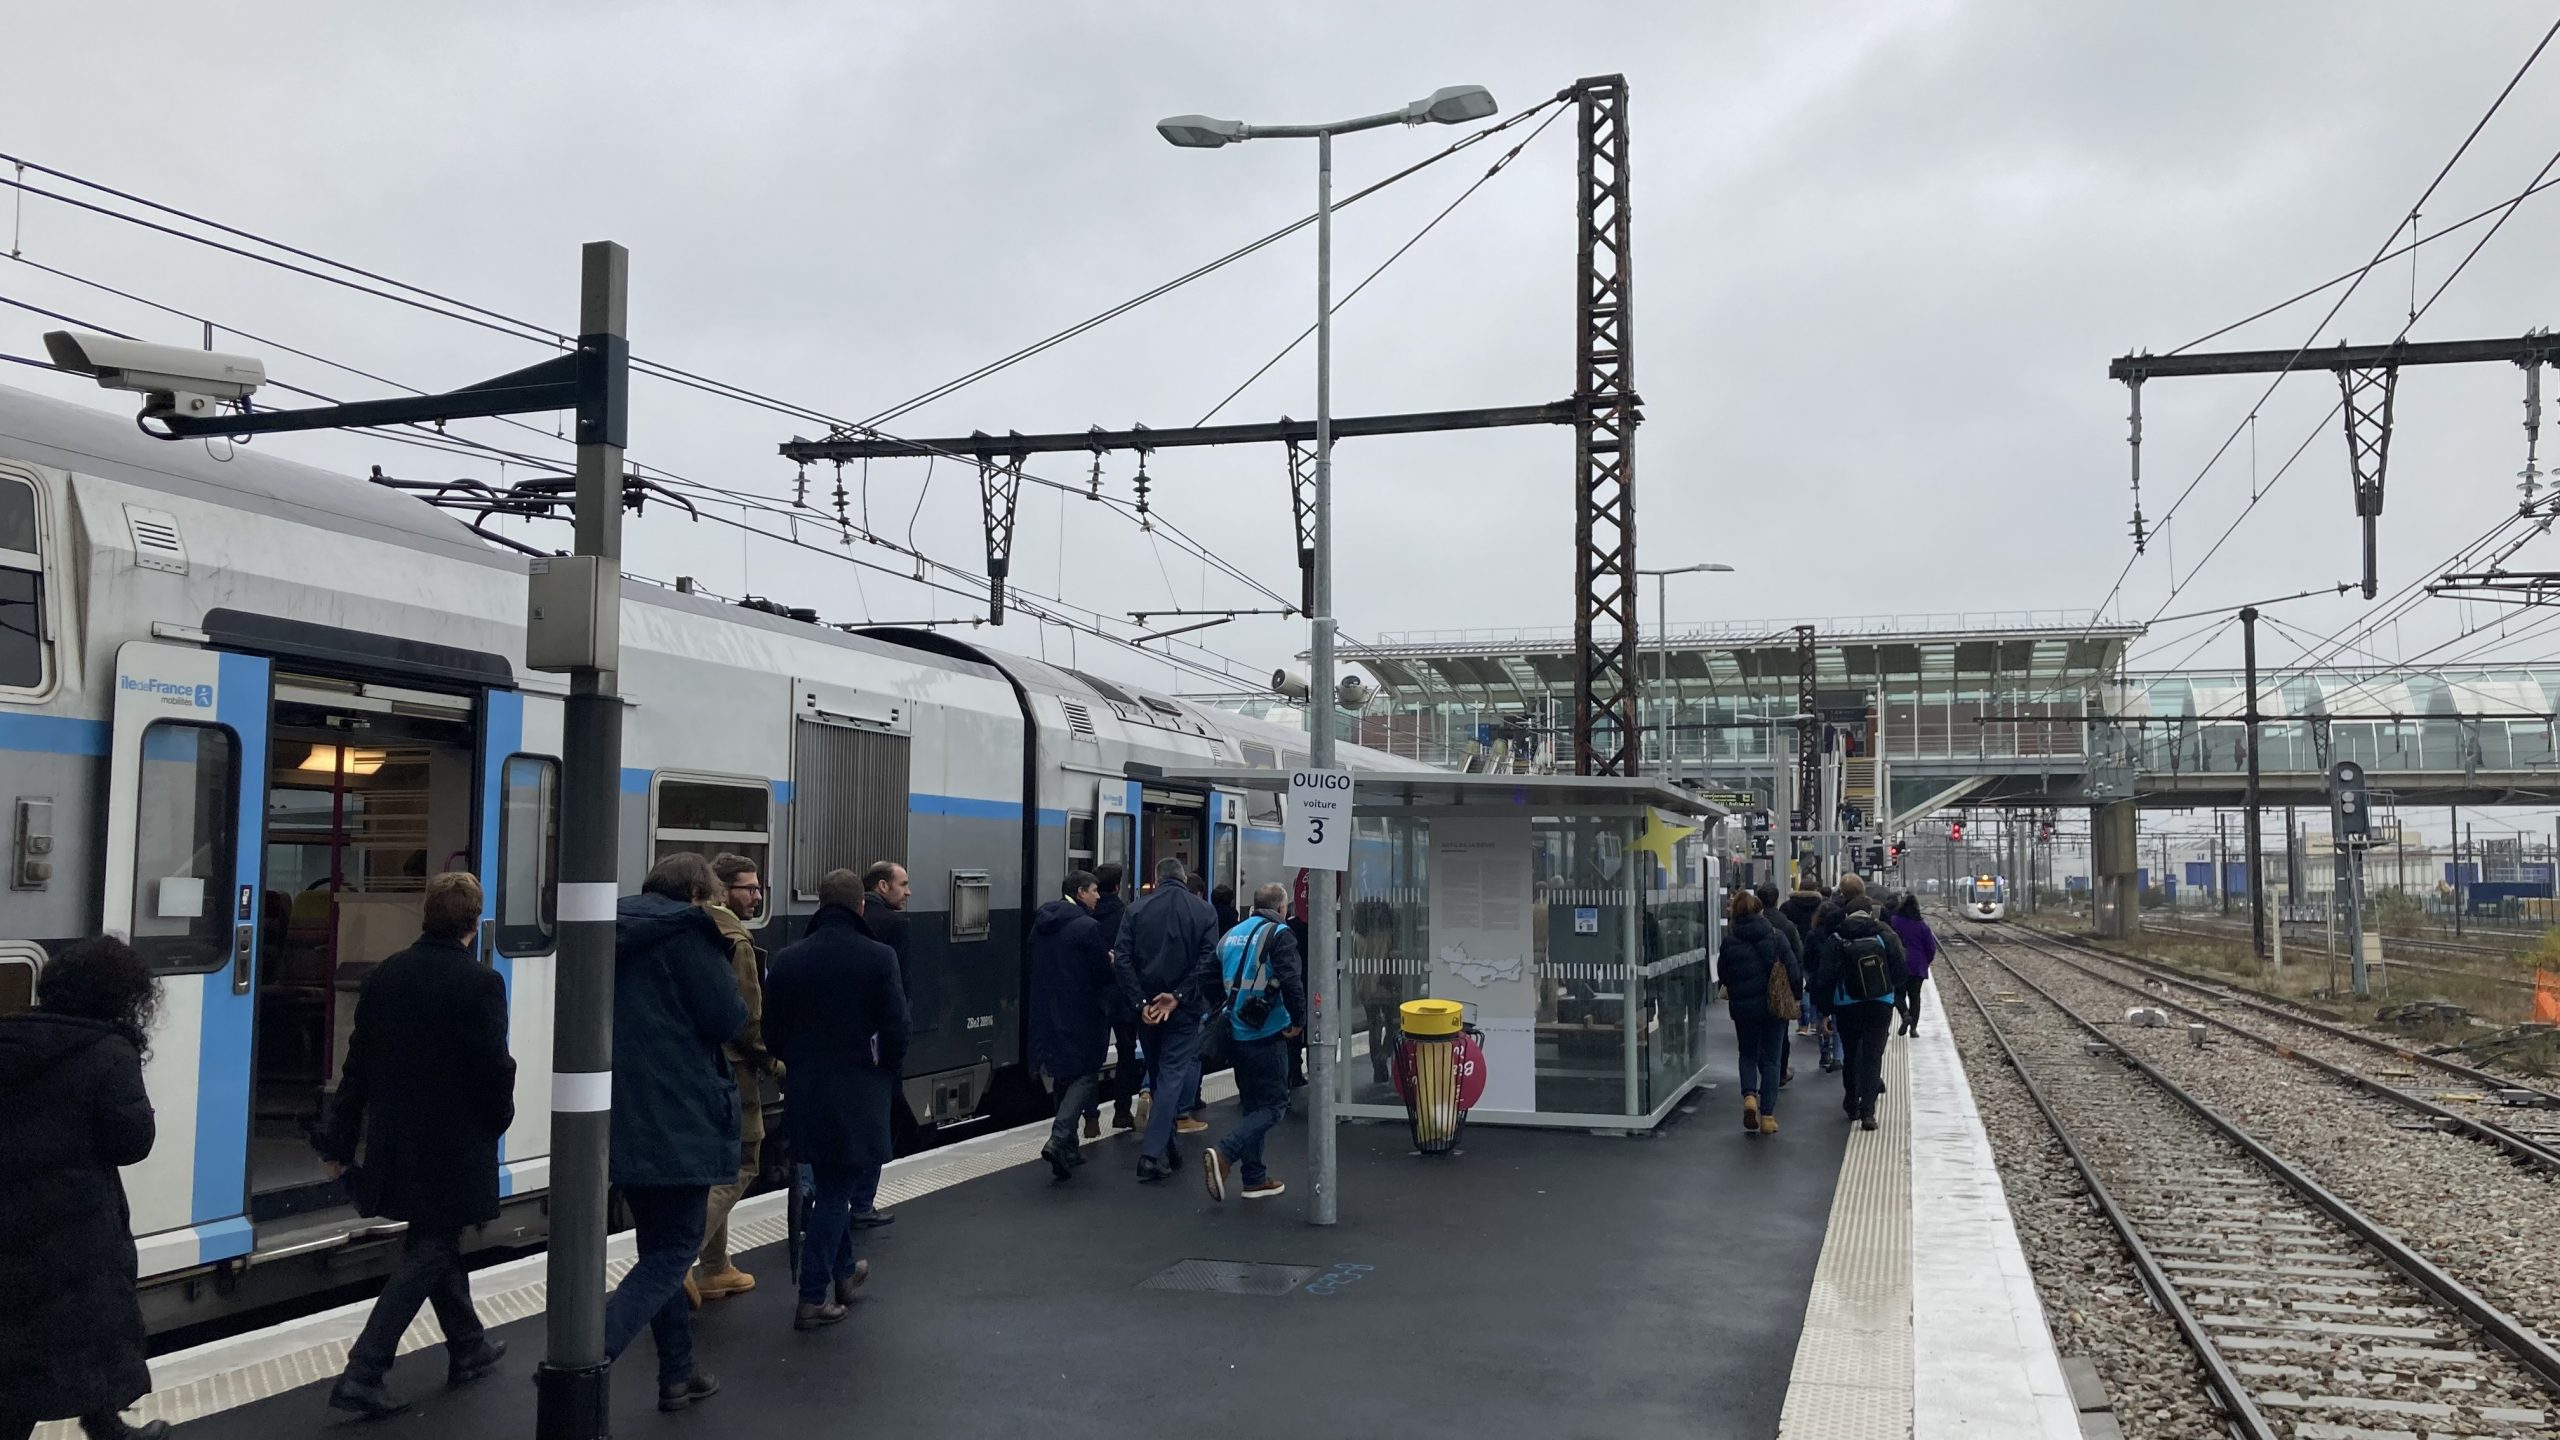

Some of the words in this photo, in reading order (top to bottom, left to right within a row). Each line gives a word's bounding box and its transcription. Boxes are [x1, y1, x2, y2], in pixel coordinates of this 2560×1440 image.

[1293, 772, 1351, 790] OUIGO
[1303, 799, 1337, 809] voiture
[1307, 819, 1324, 844] 3
[1224, 934, 1259, 947] PRESE
